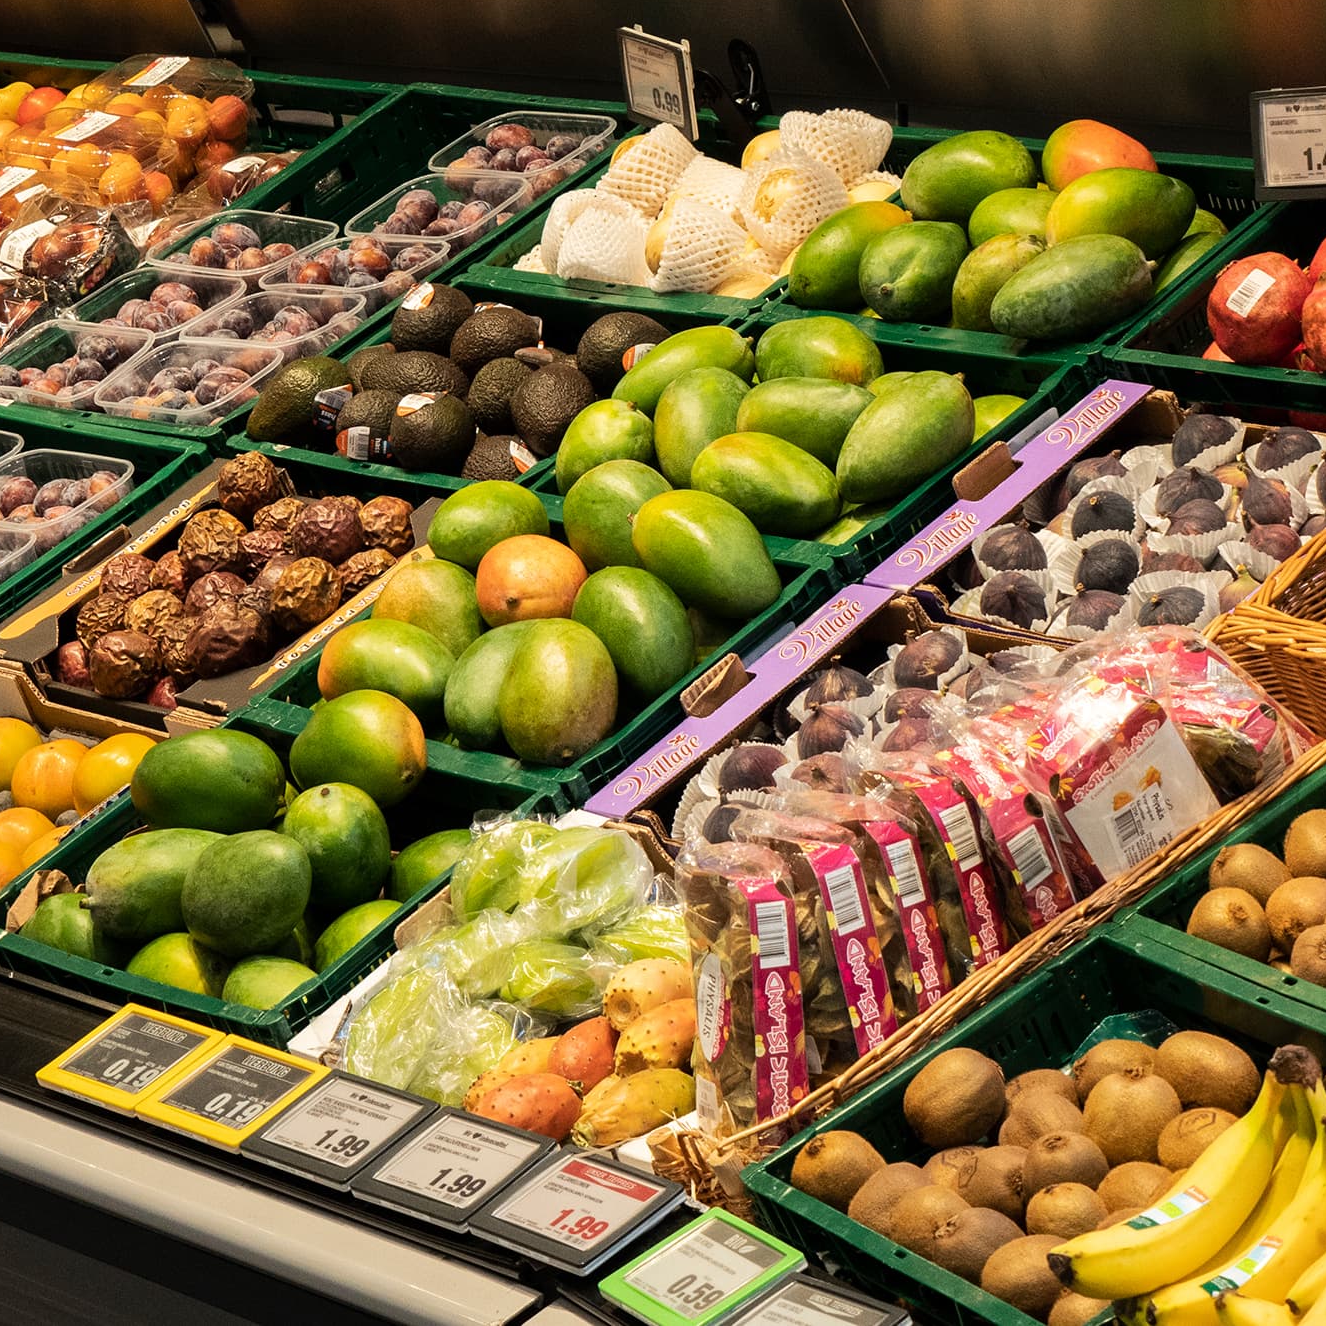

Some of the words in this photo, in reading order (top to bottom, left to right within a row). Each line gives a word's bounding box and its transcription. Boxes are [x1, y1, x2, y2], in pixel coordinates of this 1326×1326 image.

[652, 87, 681, 116] 0.99
[1045, 389, 1127, 451] Village
[896, 512, 979, 573] Village
[779, 599, 863, 666] Village
[613, 736, 702, 802] Village
[702, 973, 718, 1040] PHYSALIS
[103, 1058, 161, 1088] 0.19
[204, 1092, 265, 1123] 0.19
[314, 1128, 370, 1158] 1.99
[429, 1167, 487, 1198] 1.99
[549, 1209, 610, 1240] 1.99
[723, 1234, 748, 1250] BIO
[666, 1274, 725, 1311] 0.59
